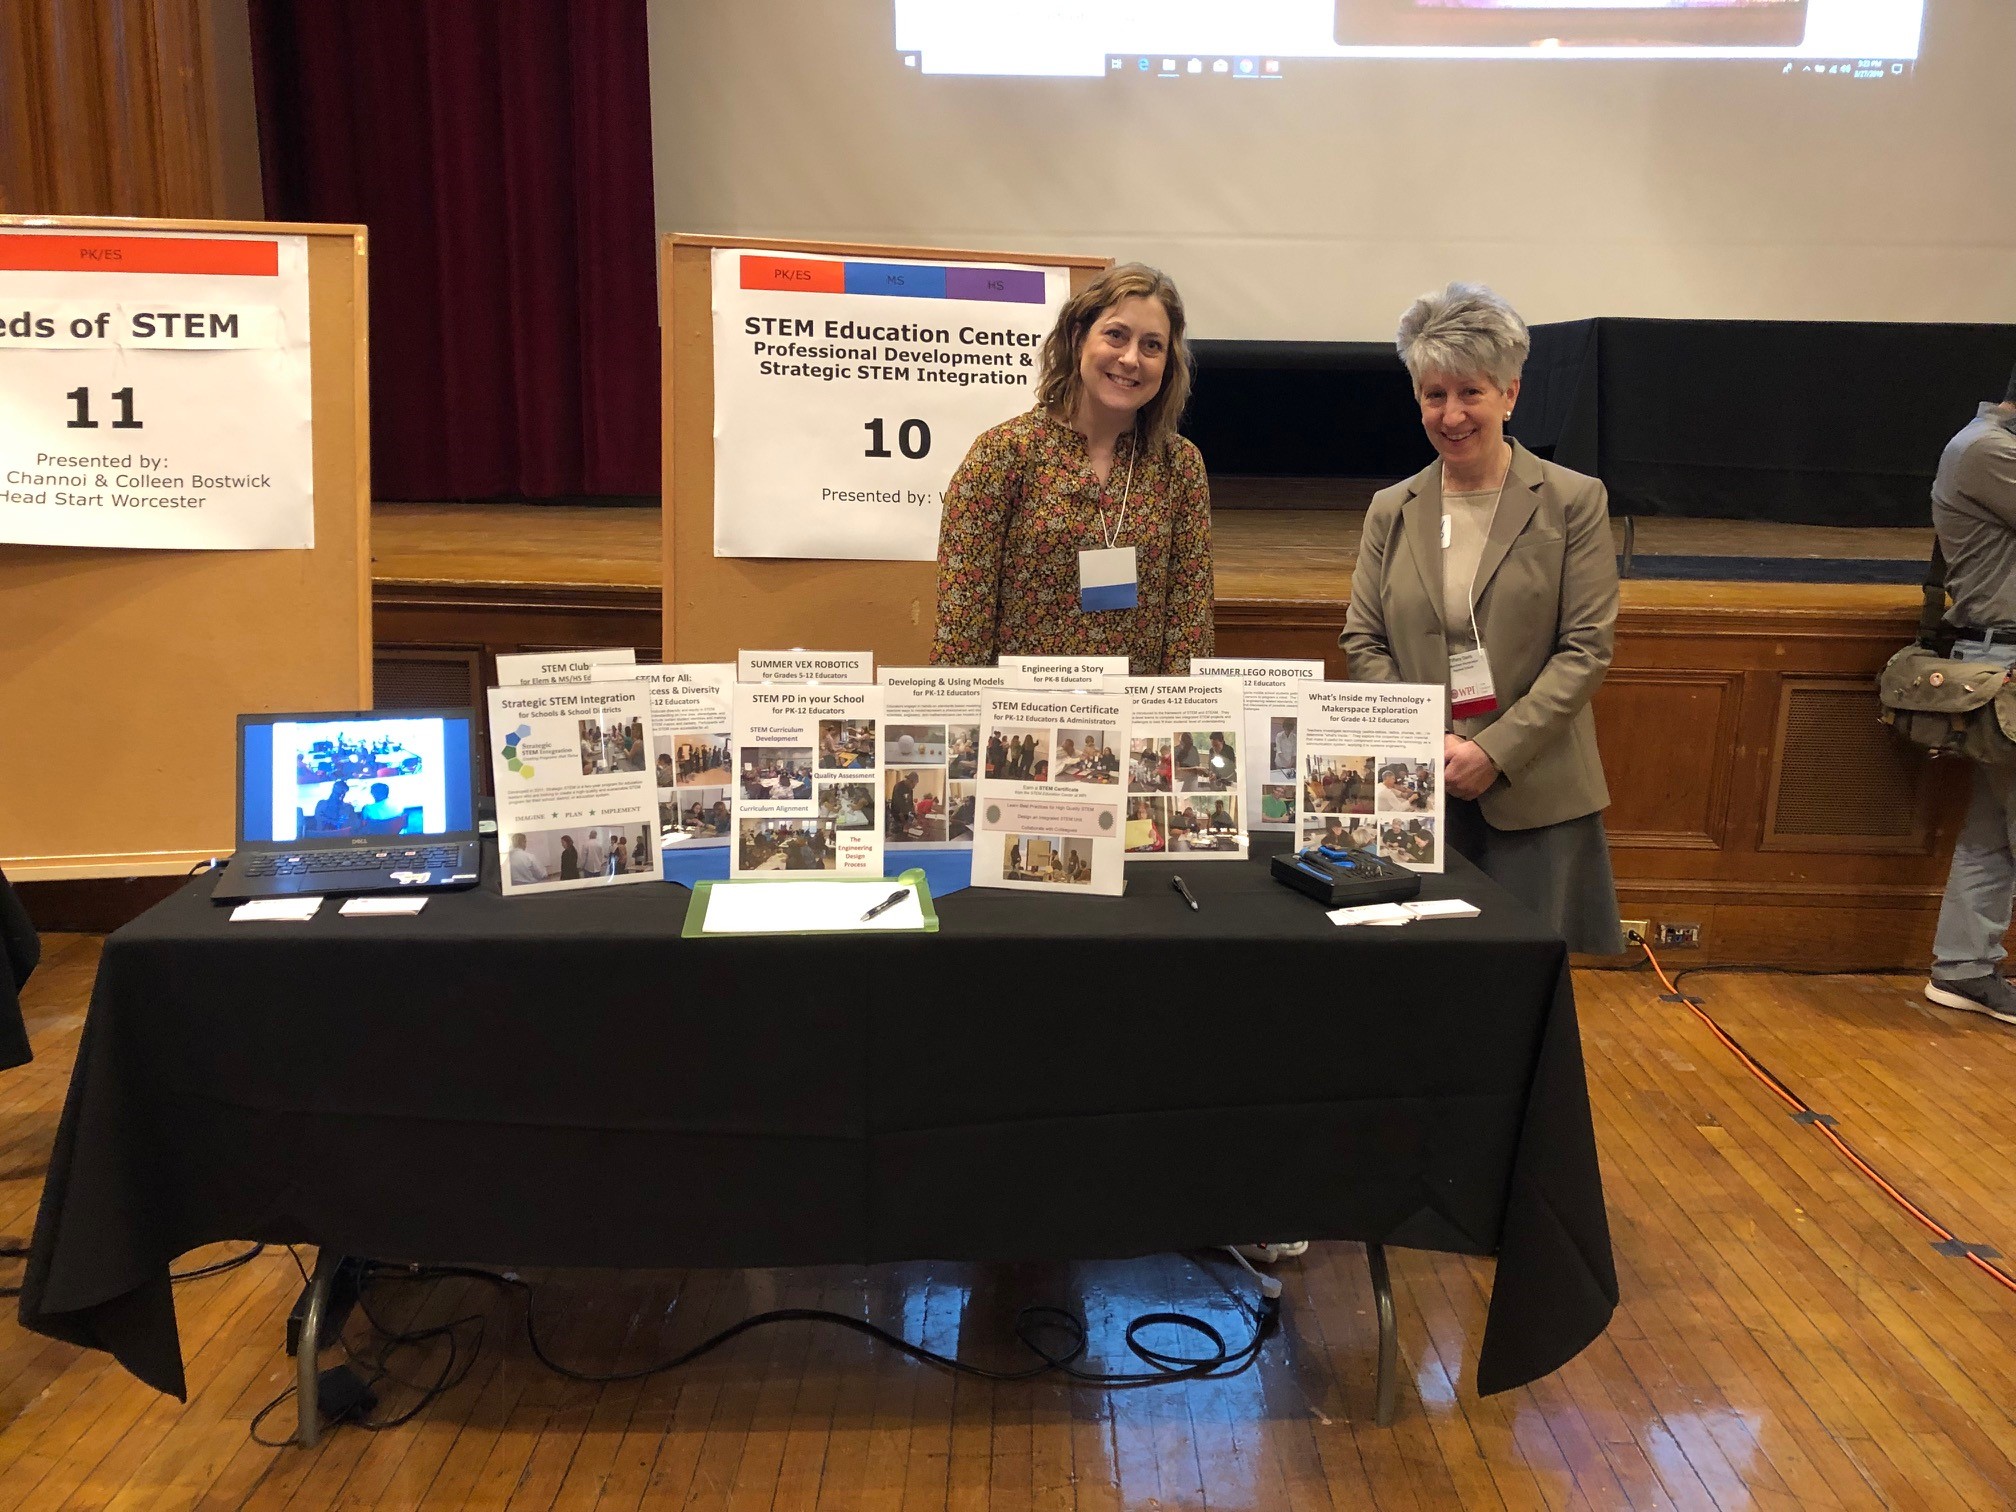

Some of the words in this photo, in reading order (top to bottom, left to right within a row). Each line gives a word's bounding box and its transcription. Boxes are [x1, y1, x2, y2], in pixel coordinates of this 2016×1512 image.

[80, 248, 121, 260] PK/ES
[774, 269, 811, 281] PK/ES
[887, 275, 905, 286] MS
[988, 280, 1004, 291] HS
[69, 312, 110, 338] of
[132, 312, 239, 338] STEM
[745, 317, 814, 337] STEM
[825, 320, 949, 343] Education
[959, 327, 1041, 347] Center
[754, 342, 877, 360] Professional
[885, 348, 1013, 367] Development
[1019, 353, 1032, 366] &
[760, 361, 851, 381] Strategic
[858, 365, 909, 381] STEM
[918, 367, 1027, 386] Integration
[67, 386, 143, 429] 11
[864, 418, 931, 459] 10
[37, 453, 131, 468] Presented
[140, 454, 168, 471] by:
[7, 471, 87, 487] Channoi
[94, 474, 107, 487] &
[116, 475, 183, 488] Colleen
[192, 474, 271, 488] Bostwick
[55, 492, 103, 506] Start
[112, 494, 206, 508] Worcester
[822, 488, 900, 503] Presented
[908, 489, 931, 505] by:
[542, 664, 566, 673] STEM
[569, 663, 589, 671] Club
[1022, 665, 1072, 674] Engineering
[1082, 665, 1103, 674] Story
[1200, 668, 1240, 676] SUMMER
[1269, 669, 1313, 677] ROBOTICS
[678, 674, 692, 682] All:
[889, 678, 936, 687] Developing
[948, 678, 970, 687] Using
[973, 678, 1004, 686] Models
[682, 686, 719, 694] Diversity
[1124, 686, 1147, 694] STEM
[1150, 686, 1154, 695] /
[1157, 686, 1186, 694] STEAM
[1189, 686, 1222, 695] Projects
[1459, 686, 1475, 696] WPI
[502, 698, 546, 709] Strategic
[550, 696, 577, 706] STEM
[581, 694, 635, 704] Integration
[753, 695, 778, 703] STEM
[810, 696, 830, 705] your
[833, 695, 864, 703] School
[1379, 695, 1424, 704] Technology
[992, 701, 1018, 710] STEM
[1021, 703, 1067, 712] Education
[1070, 705, 1119, 714] Certificate
[1322, 705, 1369, 713] Makerspace
[1373, 706, 1418, 714] Exploration
[531, 710, 558, 718] Schools
[1026, 715, 1057, 723] Educators
[1067, 717, 1116, 725] Administrators
[601, 806, 641, 814] IMPLEMENT
